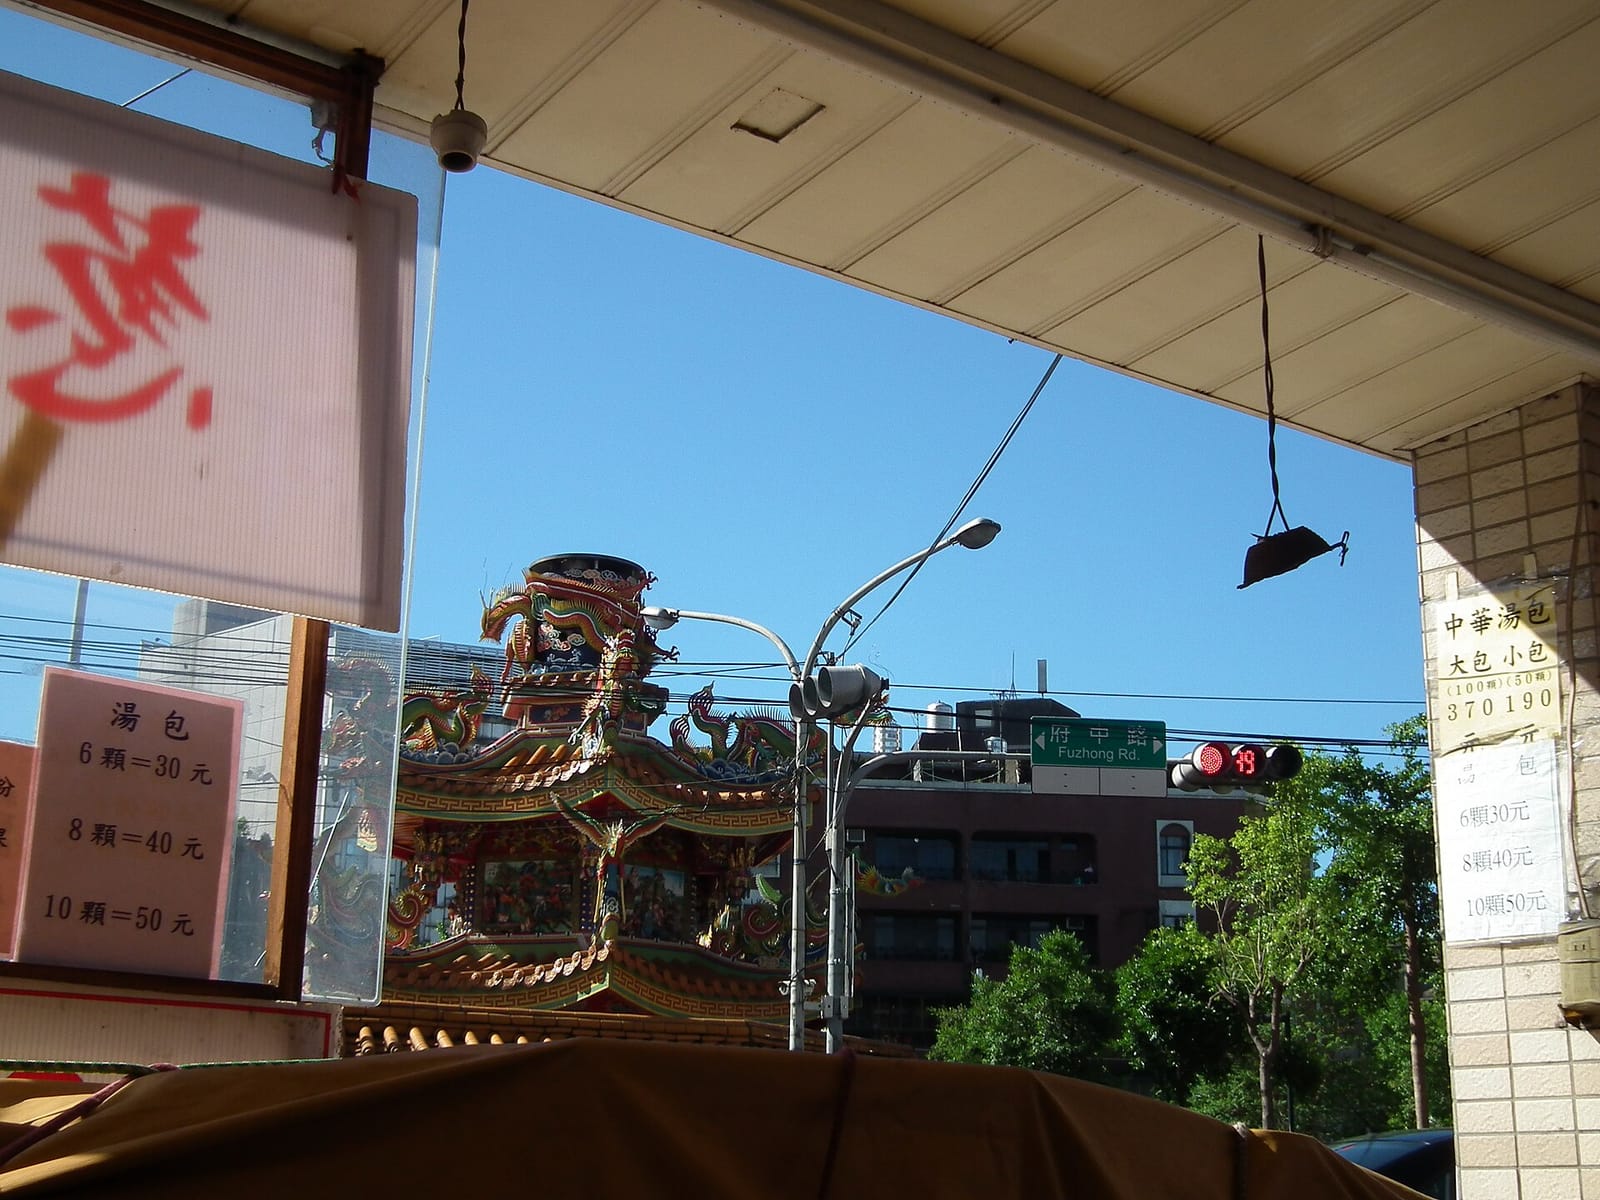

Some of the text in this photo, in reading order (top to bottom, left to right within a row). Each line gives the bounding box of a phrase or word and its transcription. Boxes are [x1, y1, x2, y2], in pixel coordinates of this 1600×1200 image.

[1444, 599, 1551, 641] 中華湯包
[1450, 640, 1548, 676] 大包 小包
[1447, 688, 1552, 721] 370 190
[110, 701, 190, 741] 湯包
[1050, 725, 1146, 747] 府中路
[1058, 747, 1140, 762] Fuzhong Rd.
[1460, 800, 1530, 828] 6顆30元
[1462, 846, 1533, 873] 8顆40元
[1467, 889, 1547, 917] 10顆50元
